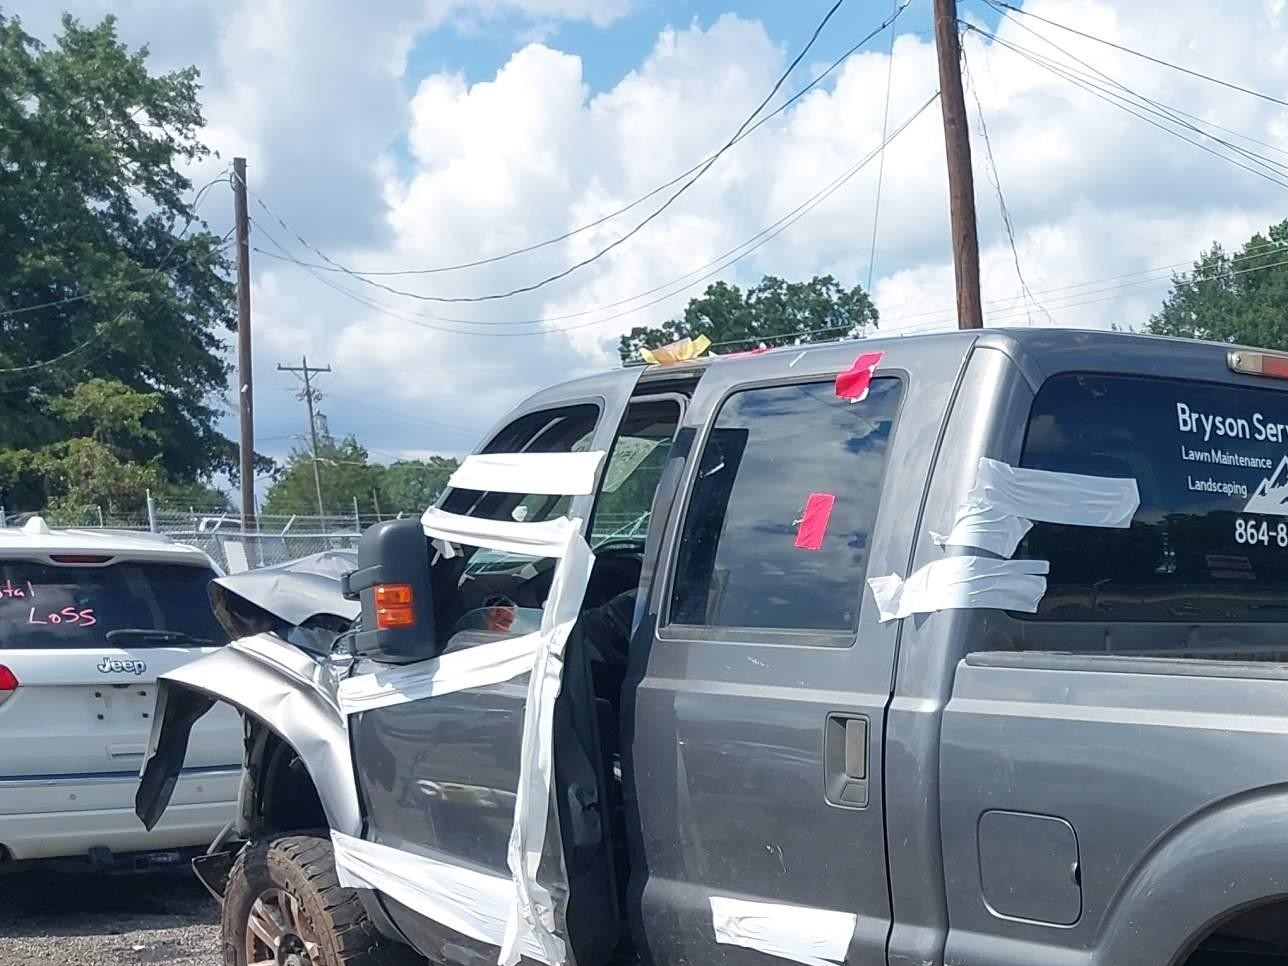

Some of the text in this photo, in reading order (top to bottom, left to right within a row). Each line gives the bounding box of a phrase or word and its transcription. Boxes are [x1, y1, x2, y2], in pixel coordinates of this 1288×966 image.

[1176, 402, 1251, 442] Bryson
[1181, 445, 1273, 470] Lawn Maintenance
[1188, 475, 1248, 499] Landscaping
[0, 579, 35, 599] tal
[96, 656, 147, 675] Jeep
